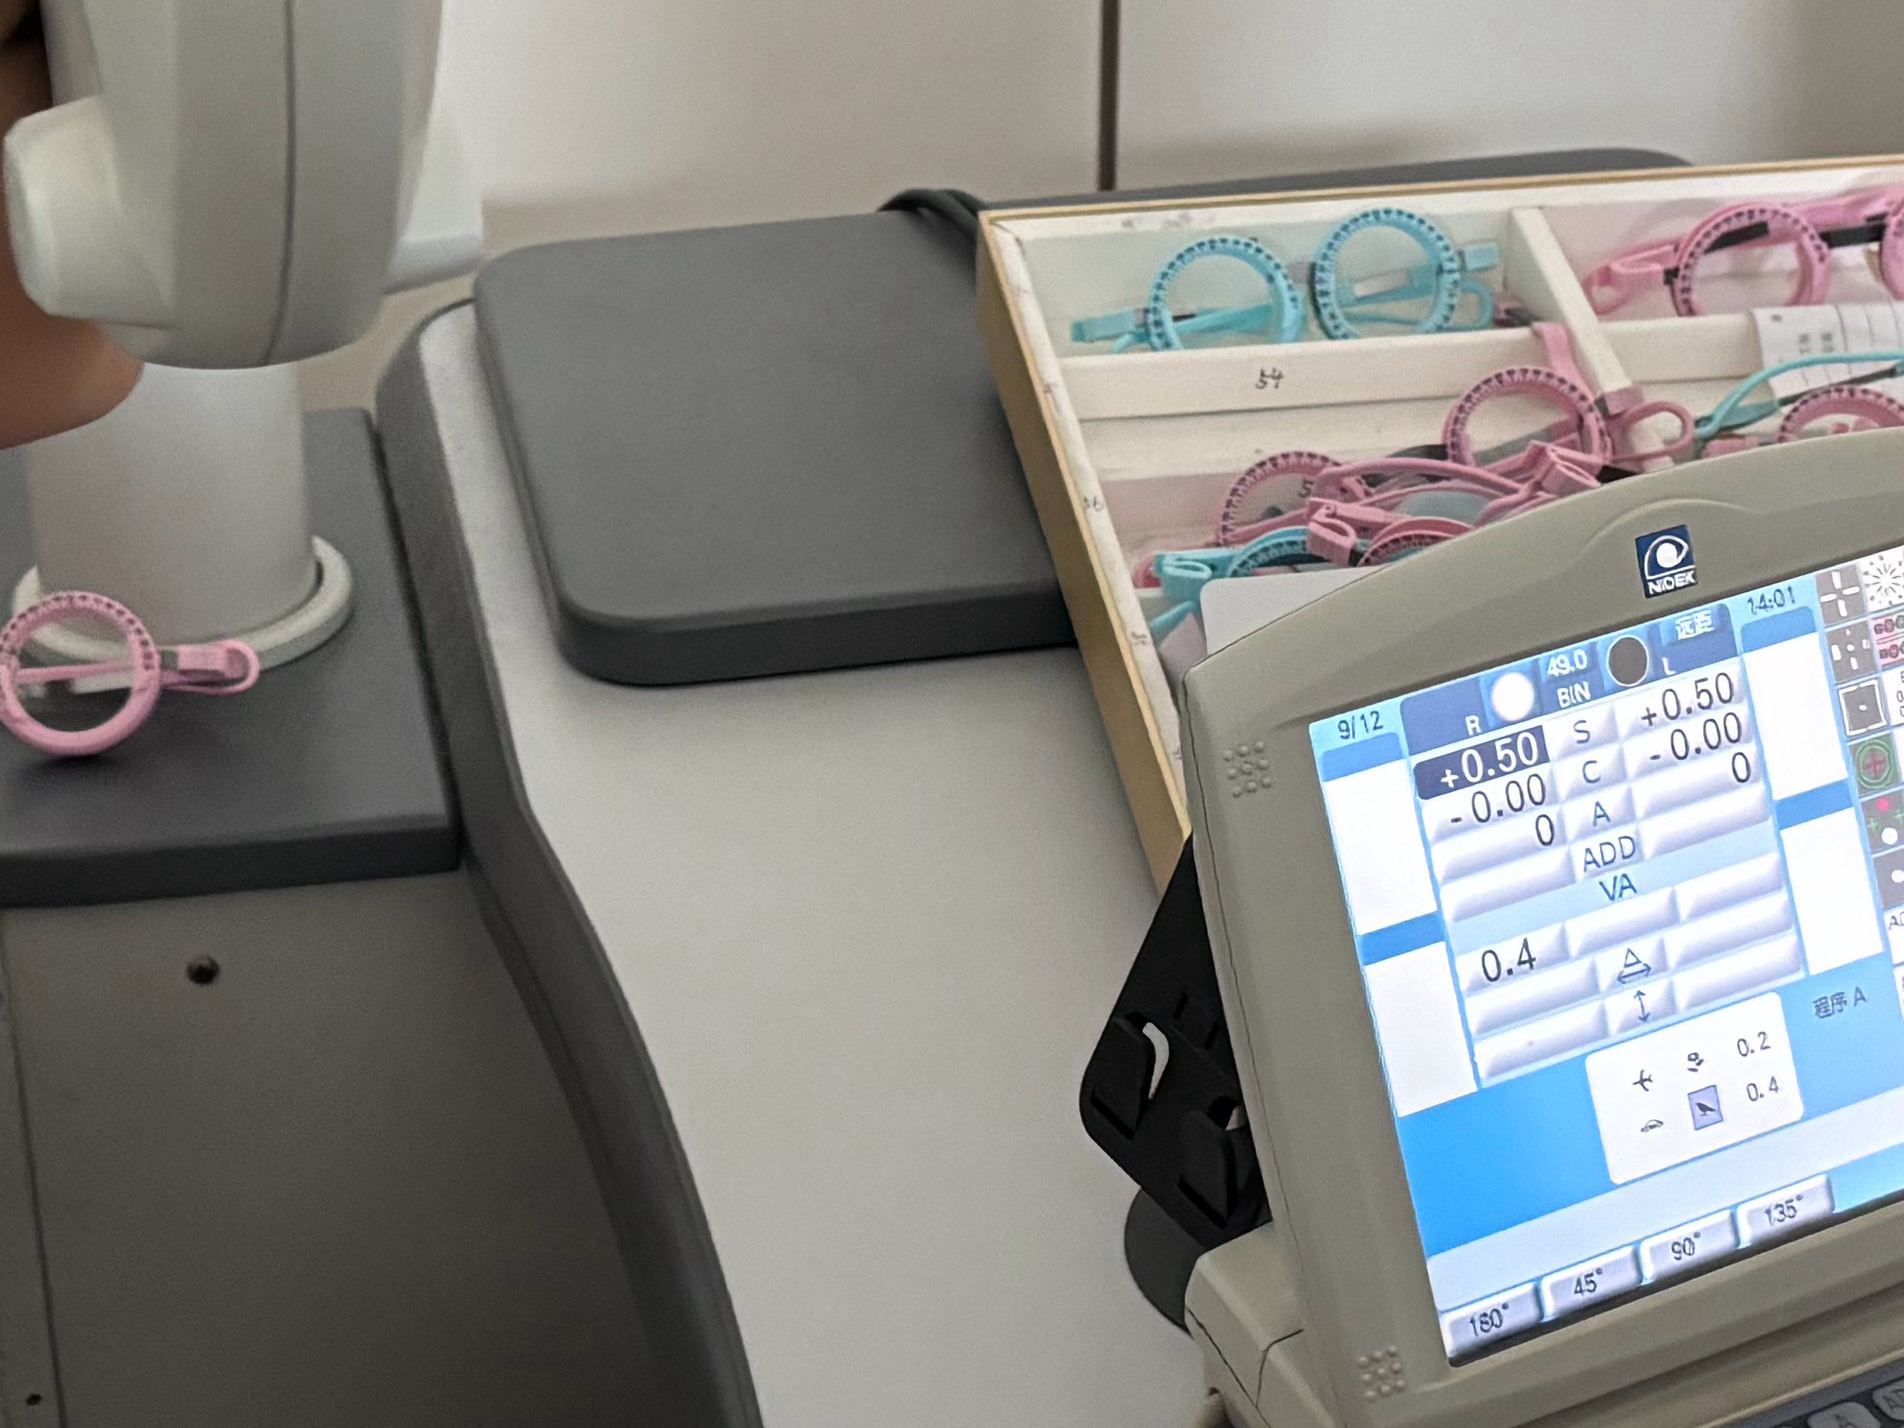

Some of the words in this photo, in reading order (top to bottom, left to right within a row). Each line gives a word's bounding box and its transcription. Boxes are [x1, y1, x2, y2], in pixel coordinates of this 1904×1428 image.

[1647, 570, 1696, 595] NIDEK
[1747, 585, 1796, 614] 14:01
[1547, 650, 1588, 677] 49.0
[1661, 657, 1676, 676] L
[1557, 681, 1591, 708] BIN
[1337, 710, 1384, 740] 9/12
[1440, 731, 1539, 788] +0.50
[1573, 720, 1591, 744] S
[1641, 672, 1734, 726] +0.50
[1465, 715, 1482, 736] R
[1582, 760, 1602, 784] C
[1535, 814, 1555, 847] 0
[1592, 801, 1611, 827] A
[1731, 751, 1752, 783] 0
[1583, 836, 1637, 873] ADD
[1599, 873, 1638, 901] VA
[1481, 936, 1537, 983] 0.4
[1853, 986, 1868, 1005] A
[1736, 1031, 1772, 1058] 0.2
[1745, 1076, 1781, 1103] 0.4
